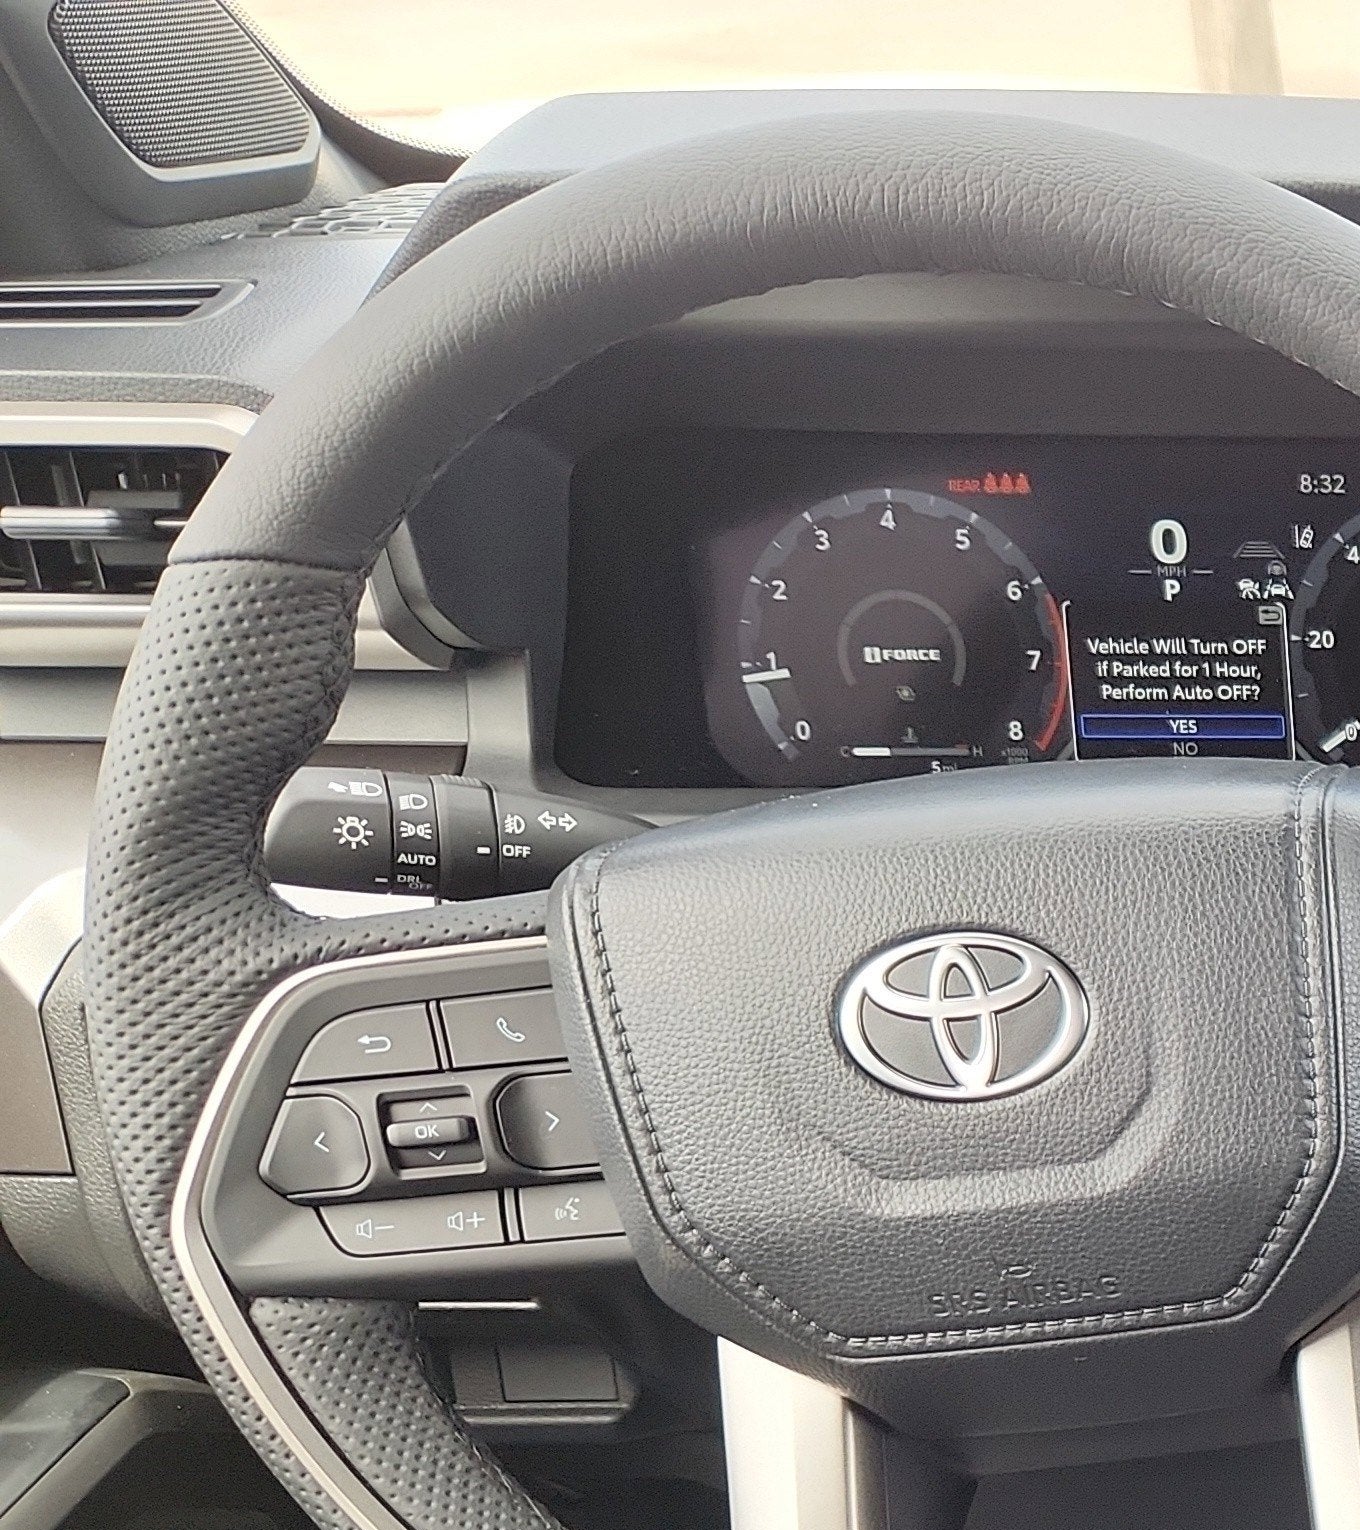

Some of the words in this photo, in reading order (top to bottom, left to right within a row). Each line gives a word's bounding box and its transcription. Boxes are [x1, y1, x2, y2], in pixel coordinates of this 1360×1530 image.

[1300, 474, 1346, 495] 8:32
[879, 509, 897, 532] 4
[814, 530, 832, 552] 3
[954, 528, 971, 550] 5
[1152, 519, 1188, 564] 0
[1157, 566, 1187, 577] MPH
[771, 579, 789, 601] 2
[1006, 580, 1024, 601] 6
[1165, 578, 1181, 602] P
[1087, 637, 1150, 656] Vehicle
[1153, 637, 1188, 656] Will
[1190, 638, 1229, 655] Turn
[1232, 638, 1267, 655] OFF
[1308, 630, 1335, 649] 20
[767, 651, 778, 672] 1
[1026, 650, 1041, 671] 7
[1098, 660, 1109, 678] if
[1113, 660, 1170, 678] Parked
[1174, 660, 1199, 678] for
[1202, 661, 1211, 678] 1
[1215, 661, 1262, 680] Hour,
[1101, 683, 1169, 701] Perform
[1172, 684, 1214, 701] Auto
[1217, 684, 1261, 701] OFF?
[795, 720, 812, 741] 0
[1008, 720, 1024, 741] 8
[1169, 719, 1198, 734] YES
[1173, 742, 1199, 756] NO
[396, 853, 437, 866] AUTO
[502, 844, 531, 858] OFF
[415, 1124, 440, 1138] OK
